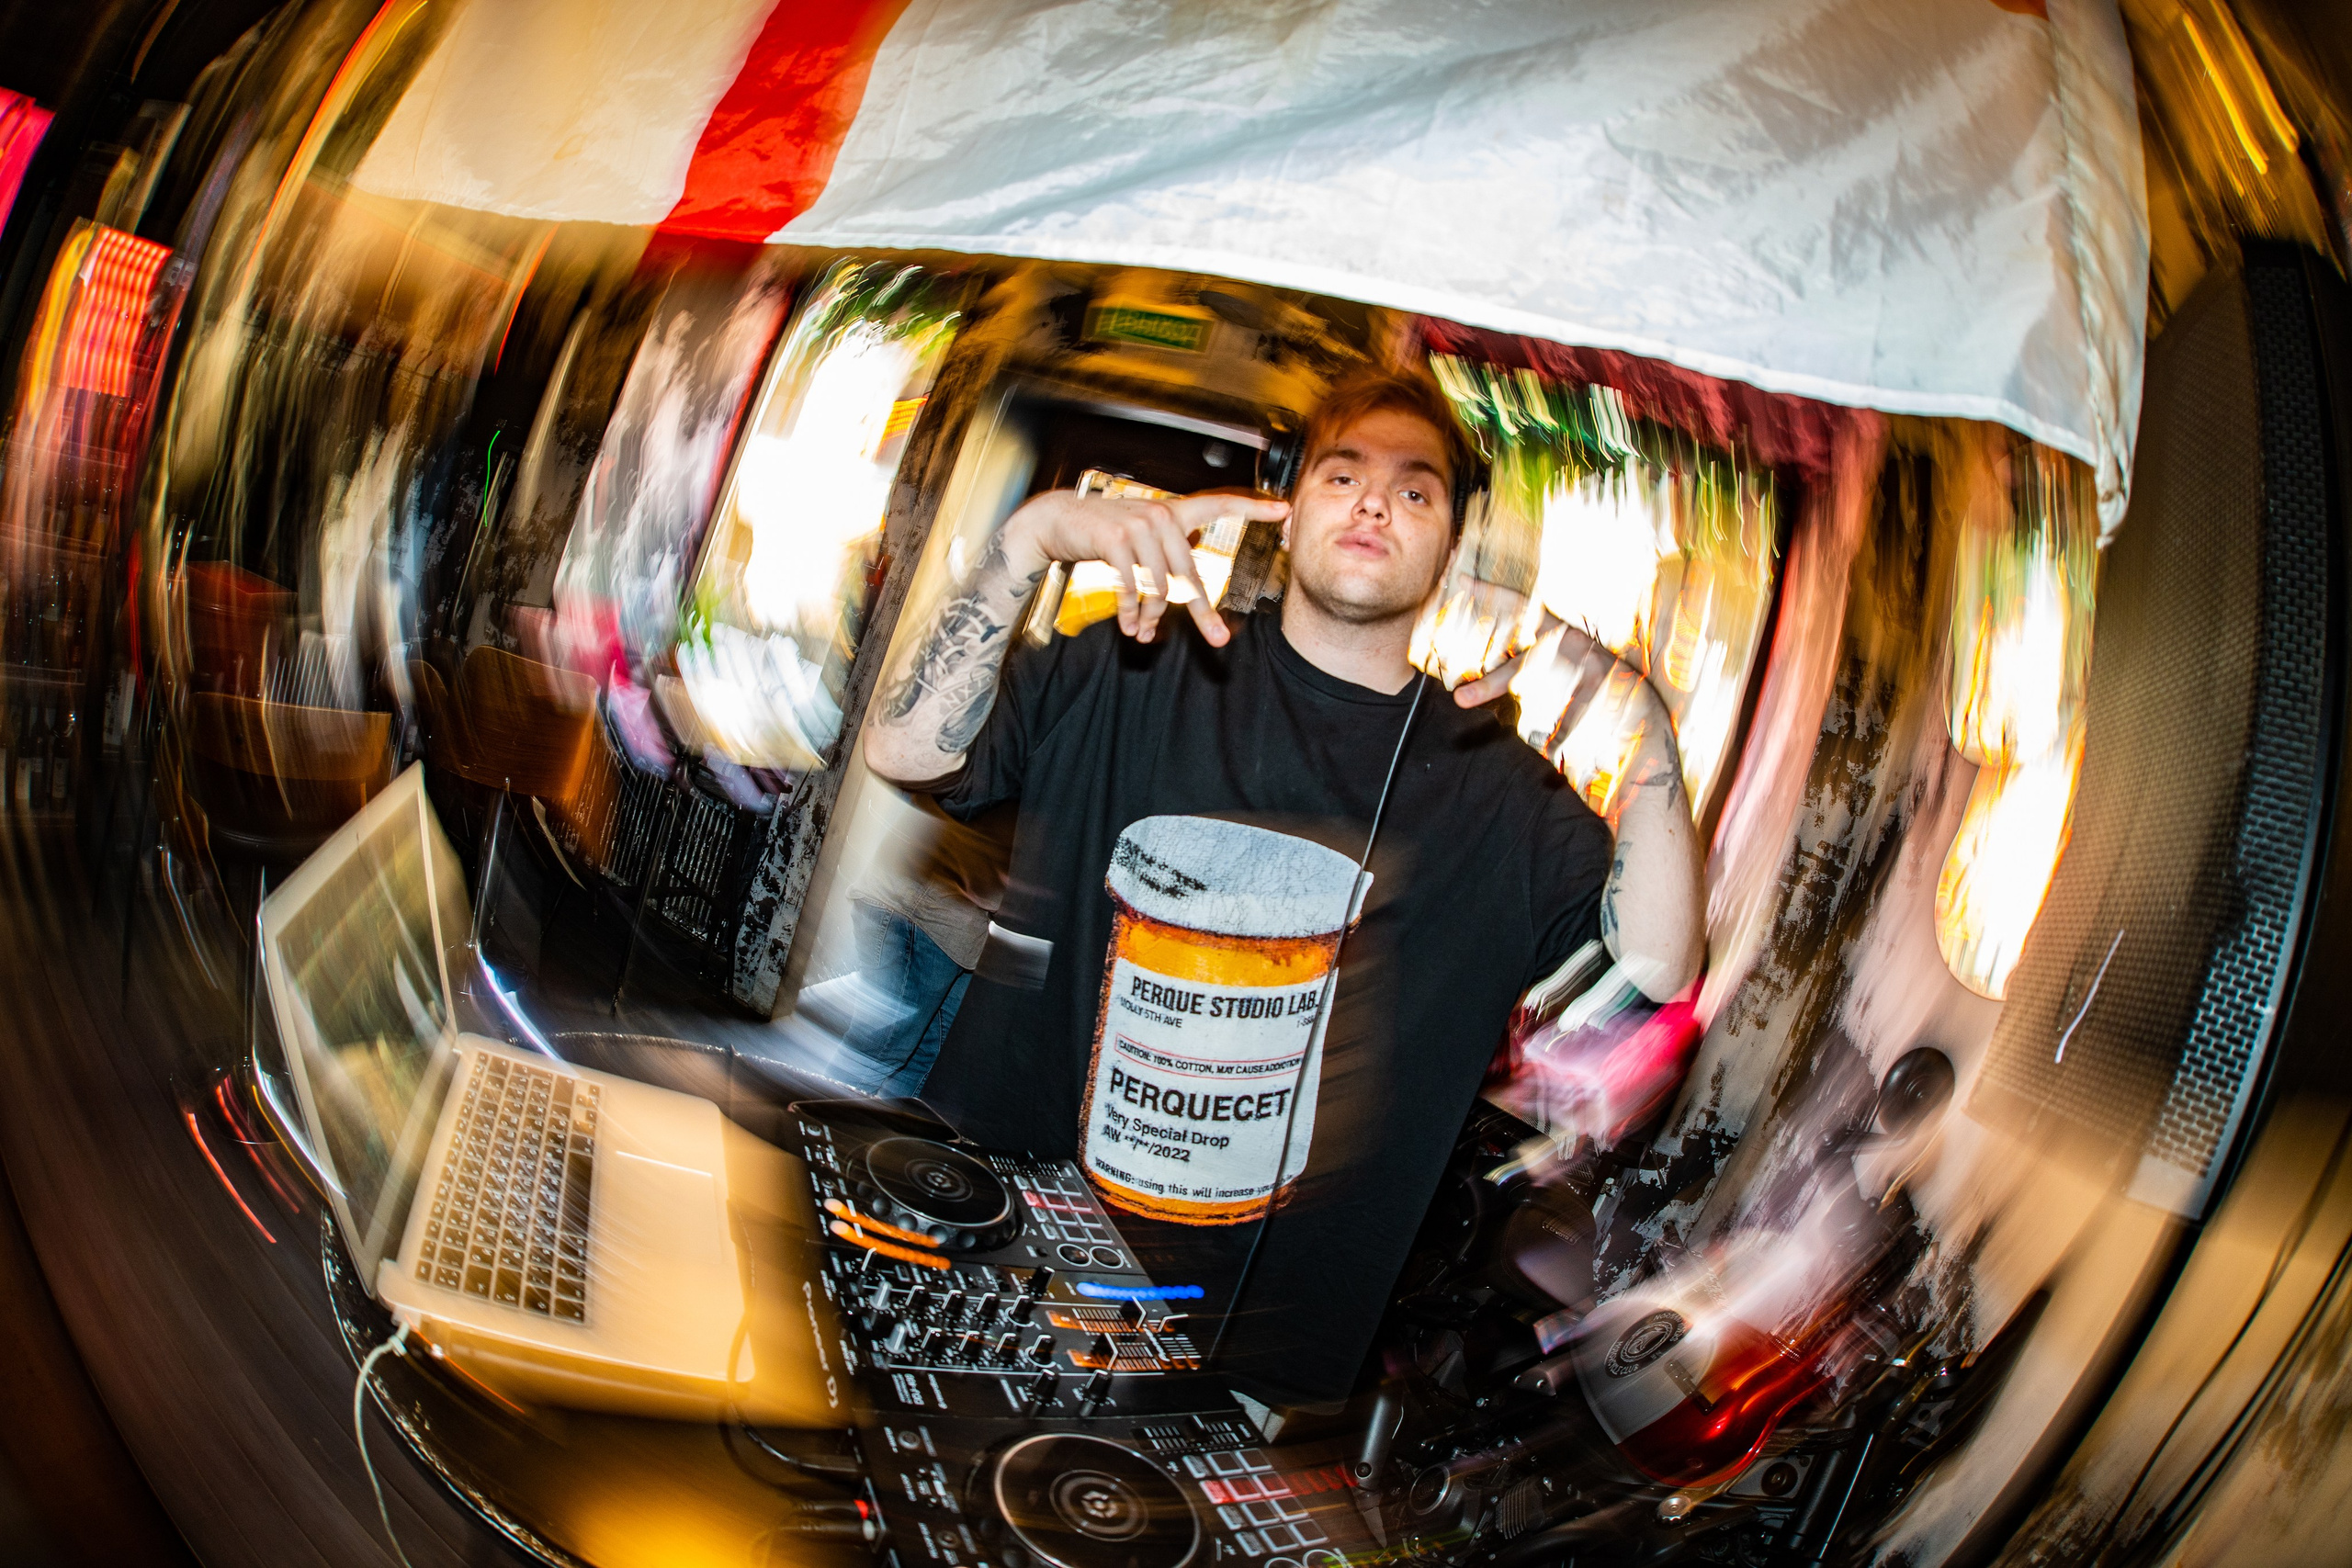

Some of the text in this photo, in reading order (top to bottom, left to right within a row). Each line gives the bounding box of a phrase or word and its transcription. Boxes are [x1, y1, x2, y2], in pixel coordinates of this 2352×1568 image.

[1130, 976, 1205, 1015] PERQUE
[1209, 996, 1284, 1019] STUDIO
[1144, 1009, 1161, 1023] 5TH
[1163, 1017, 1182, 1028] AVE
[1118, 1039, 1152, 1062] CAUTION:
[1153, 1055, 1173, 1067] 100%
[1175, 1060, 1215, 1074] COTTON,
[1216, 1066, 1235, 1074] MAY
[1236, 1065, 1265, 1074] CAUSE
[1110, 1067, 1291, 1122] PERQUECET
[1102, 1124, 1121, 1143] AW
[1104, 1102, 1229, 1150] Very Special Drop
[1094, 1156, 1135, 1185] WARNING:
[1138, 1178, 1164, 1195] using
[1169, 1183, 1188, 1196] this
[1193, 1187, 1212, 1198] will
[1215, 1187, 1255, 1198] increase
